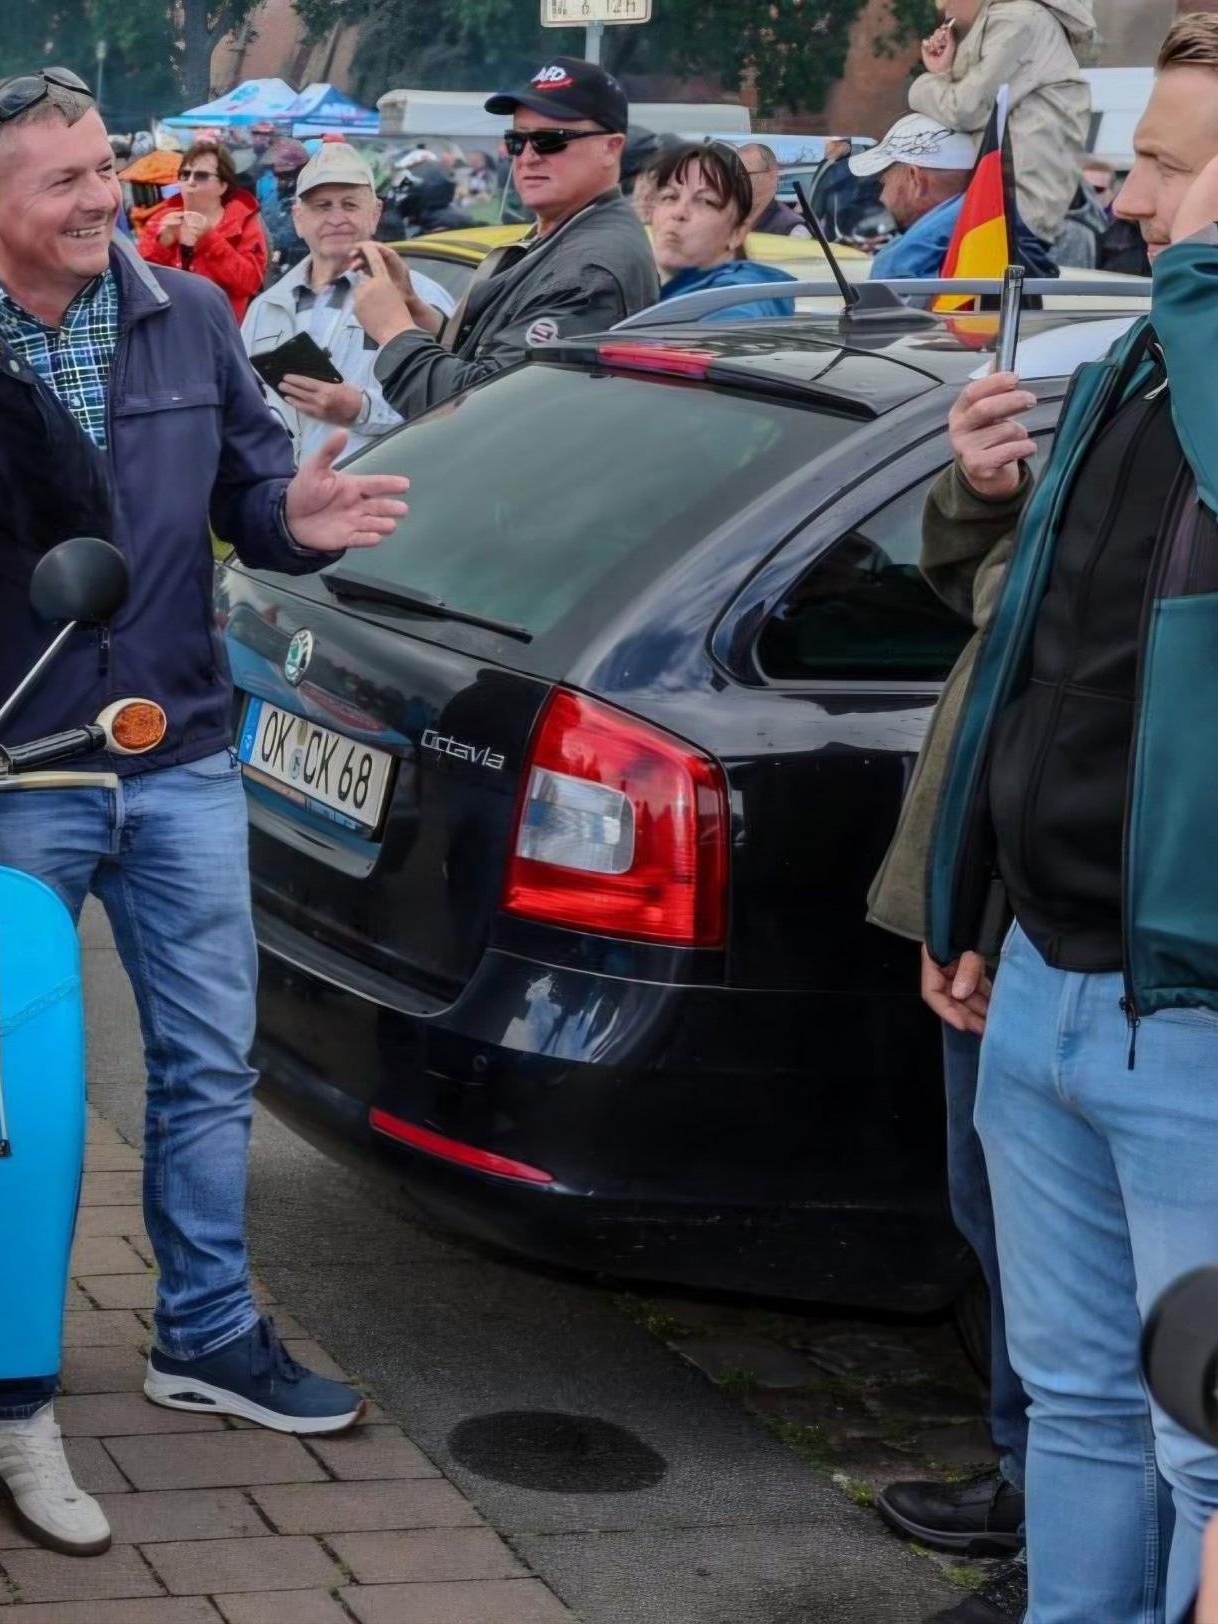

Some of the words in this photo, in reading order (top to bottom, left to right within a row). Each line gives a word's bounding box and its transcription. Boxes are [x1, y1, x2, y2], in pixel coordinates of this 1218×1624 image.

[261, 710, 296, 773] OK
[303, 730, 340, 795] CK
[337, 744, 373, 809] 68
